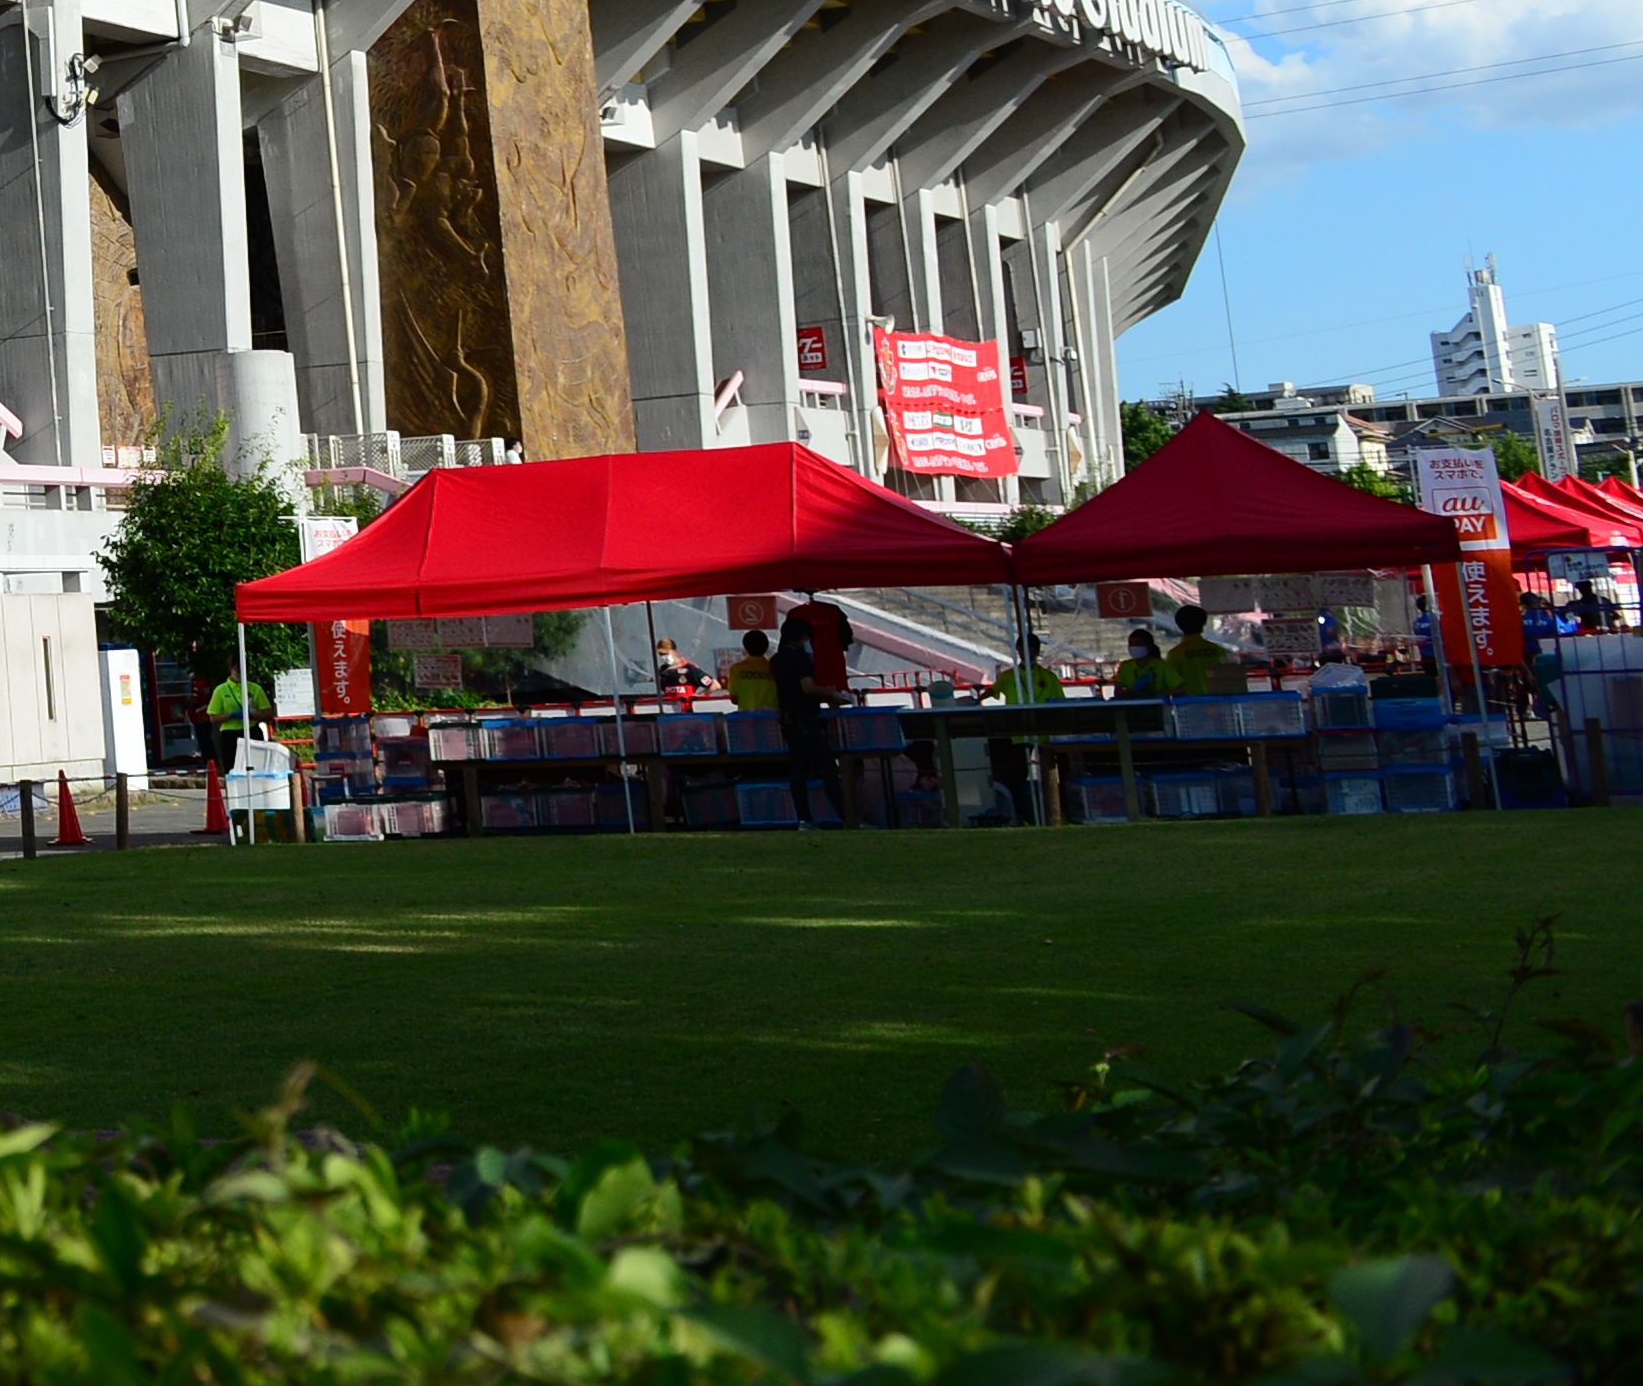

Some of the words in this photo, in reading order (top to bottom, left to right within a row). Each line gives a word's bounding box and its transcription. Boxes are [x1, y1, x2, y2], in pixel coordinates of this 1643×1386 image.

[1442, 495, 1485, 513] au
[1461, 560, 1495, 657] 使えます。
[330, 619, 352, 705] 使えます。
